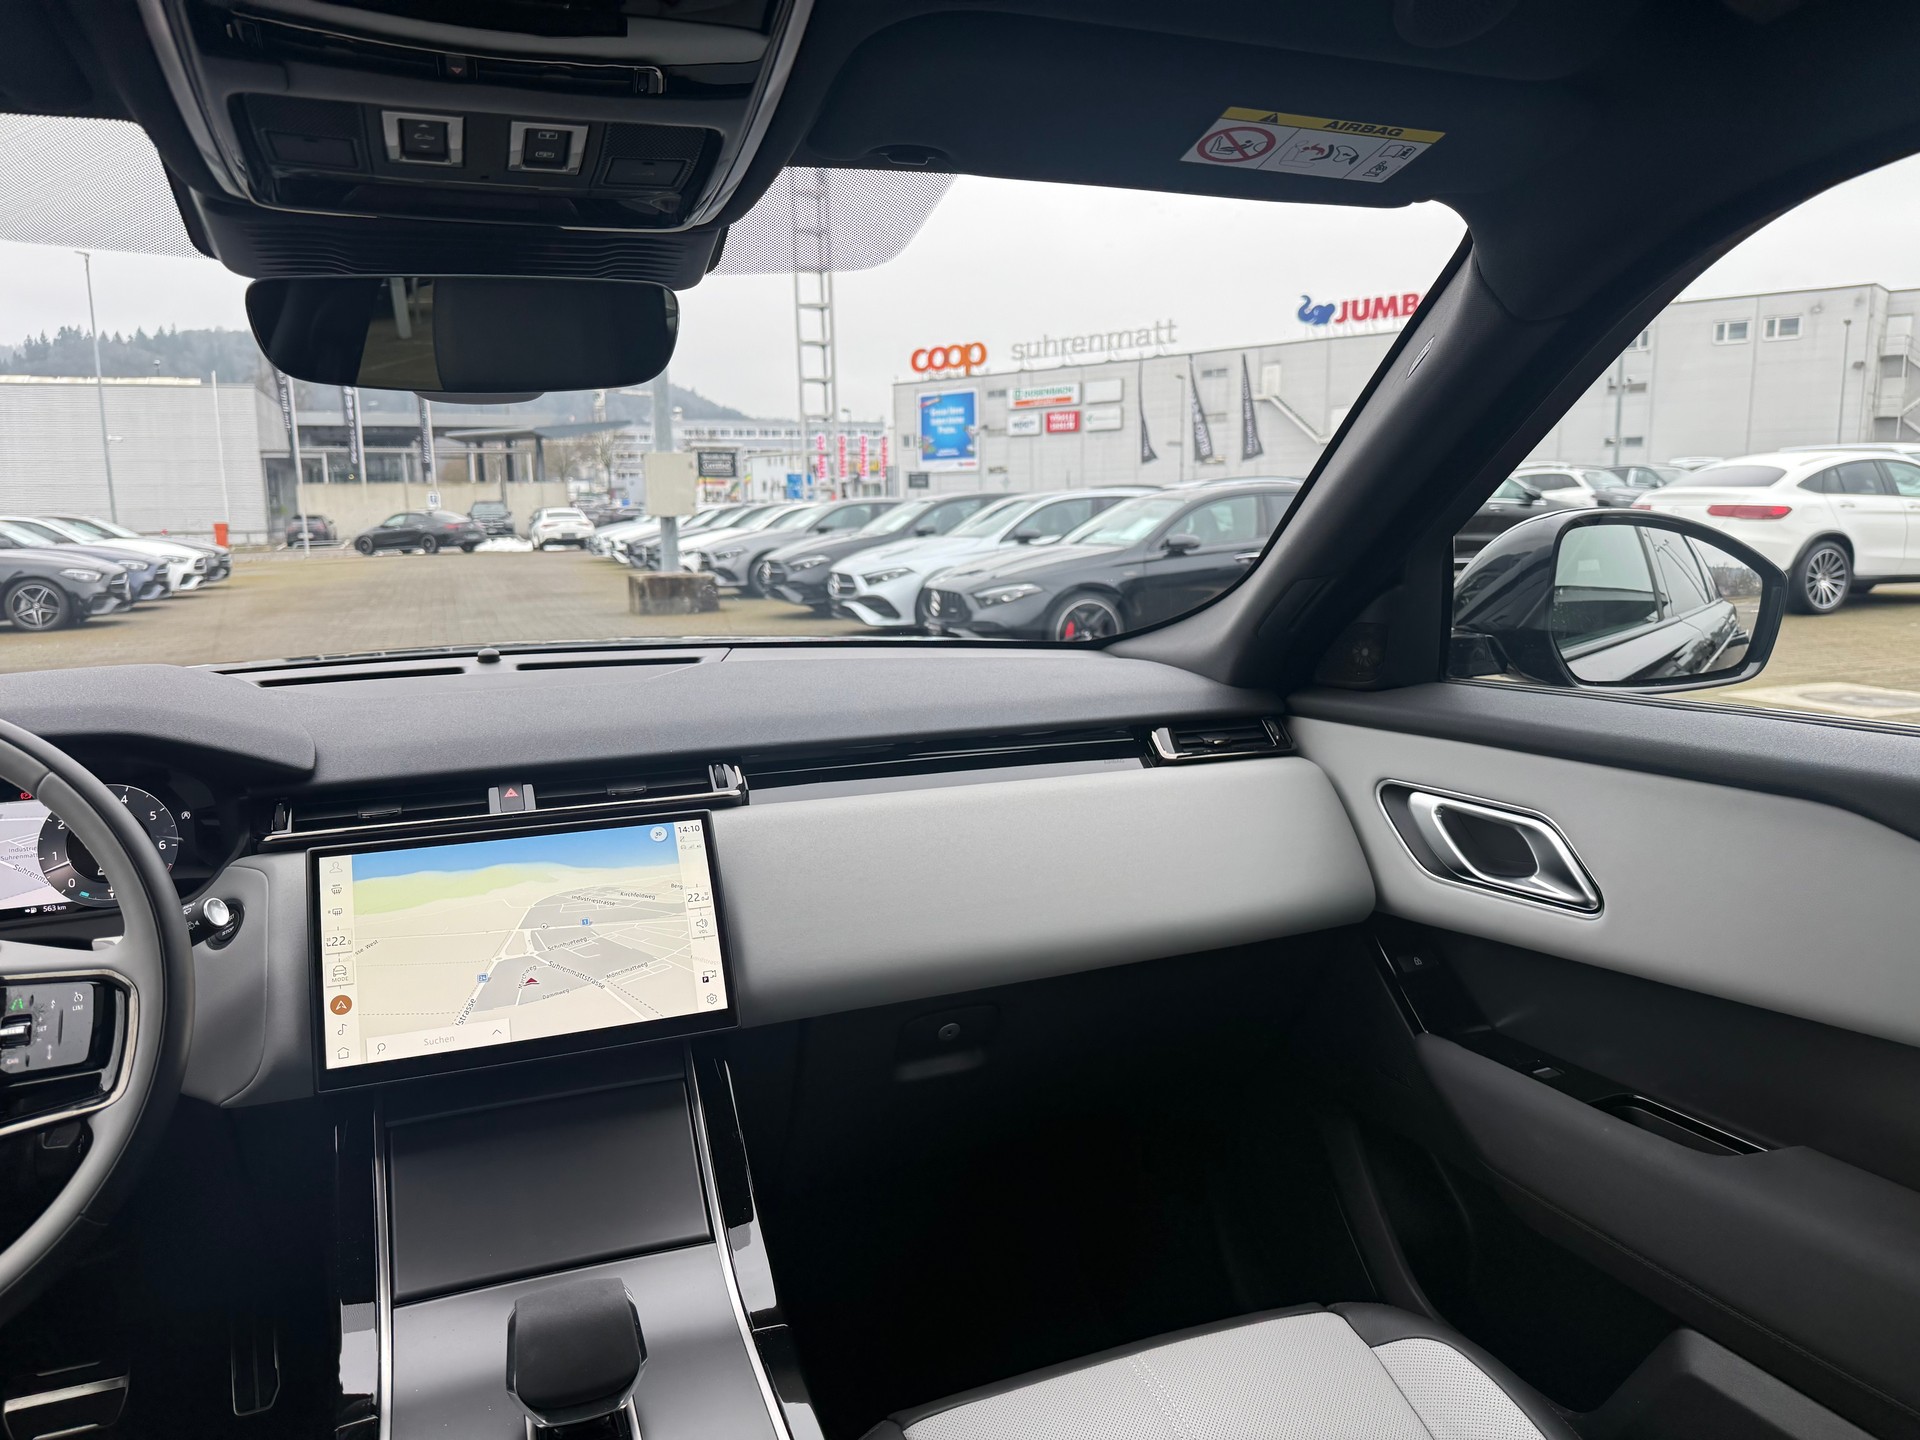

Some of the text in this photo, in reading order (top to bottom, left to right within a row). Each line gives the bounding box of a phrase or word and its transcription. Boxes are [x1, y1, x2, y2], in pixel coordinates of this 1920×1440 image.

[1323, 120, 1405, 137] AIRBAG
[1334, 293, 1421, 323] JUMB
[1011, 318, 1178, 361] suhrenmatt
[911, 342, 987, 377] coop
[120, 795, 128, 804] 4
[150, 811, 157, 820] 5
[57, 820, 65, 829] 2
[678, 825, 700, 833] 14:10
[158, 840, 166, 849] 6
[52, 851, 58, 861] 1
[13, 863, 51, 887] Suhrenma
[68, 878, 76, 888] 0
[571, 895, 615, 907] Industriestrasse
[620, 892, 656, 900] Kirchfeldweg
[518, 965, 537, 990] Marchweg
[549, 961, 606, 990] Suhrenmattstrasse
[542, 988, 570, 1000] Dammweg
[424, 1035, 455, 1046] Suchen
